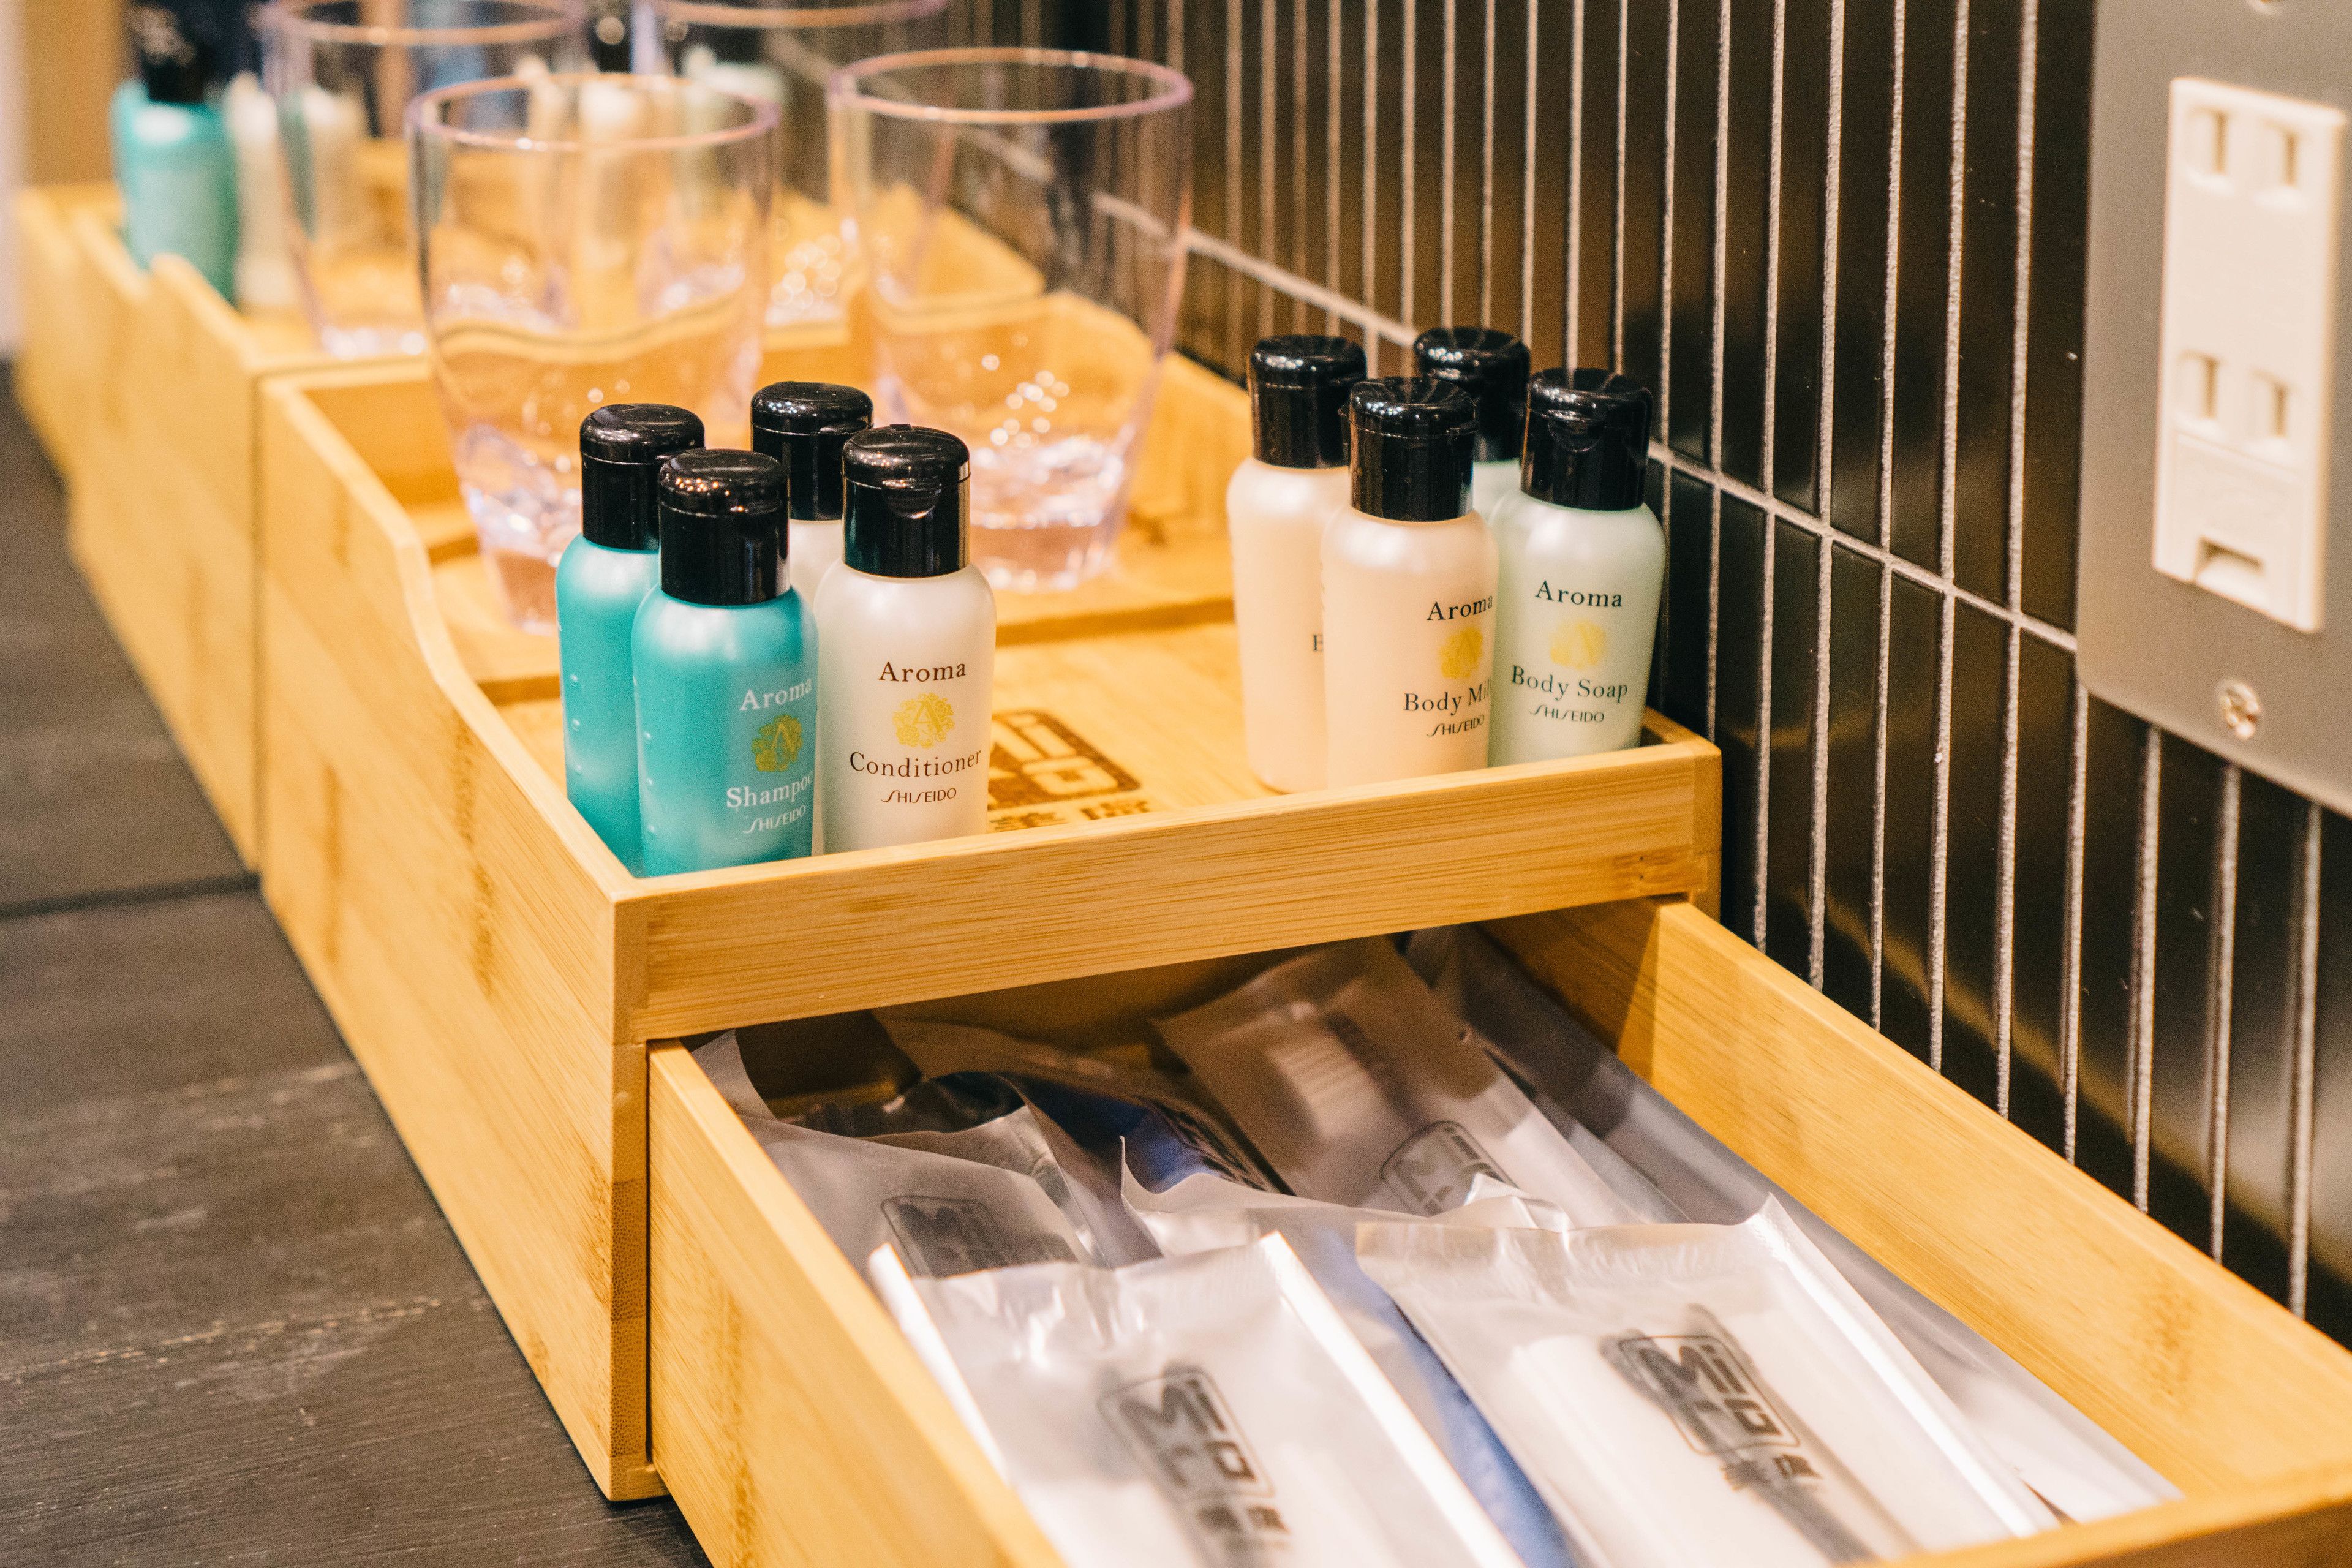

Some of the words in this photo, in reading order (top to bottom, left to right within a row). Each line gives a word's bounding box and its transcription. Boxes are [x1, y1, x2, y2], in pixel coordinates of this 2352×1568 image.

[1535, 580, 1622, 608] Aroma
[1426, 595, 1493, 621] Aroma
[878, 661, 966, 682] Aroma
[1512, 665, 1569, 701] Body
[1577, 679, 1627, 704] Soap
[739, 679, 812, 711] Aroma
[1403, 692, 1463, 716] Body
[1468, 677, 1491, 706] Mil
[1426, 714, 1485, 737] SHISEIDO
[1529, 704, 1605, 723] SHISEIDO
[850, 750, 981, 777] Conditioner
[880, 788, 957, 803] SHISEIDO
[742, 804, 807, 834] SHISEIDO
